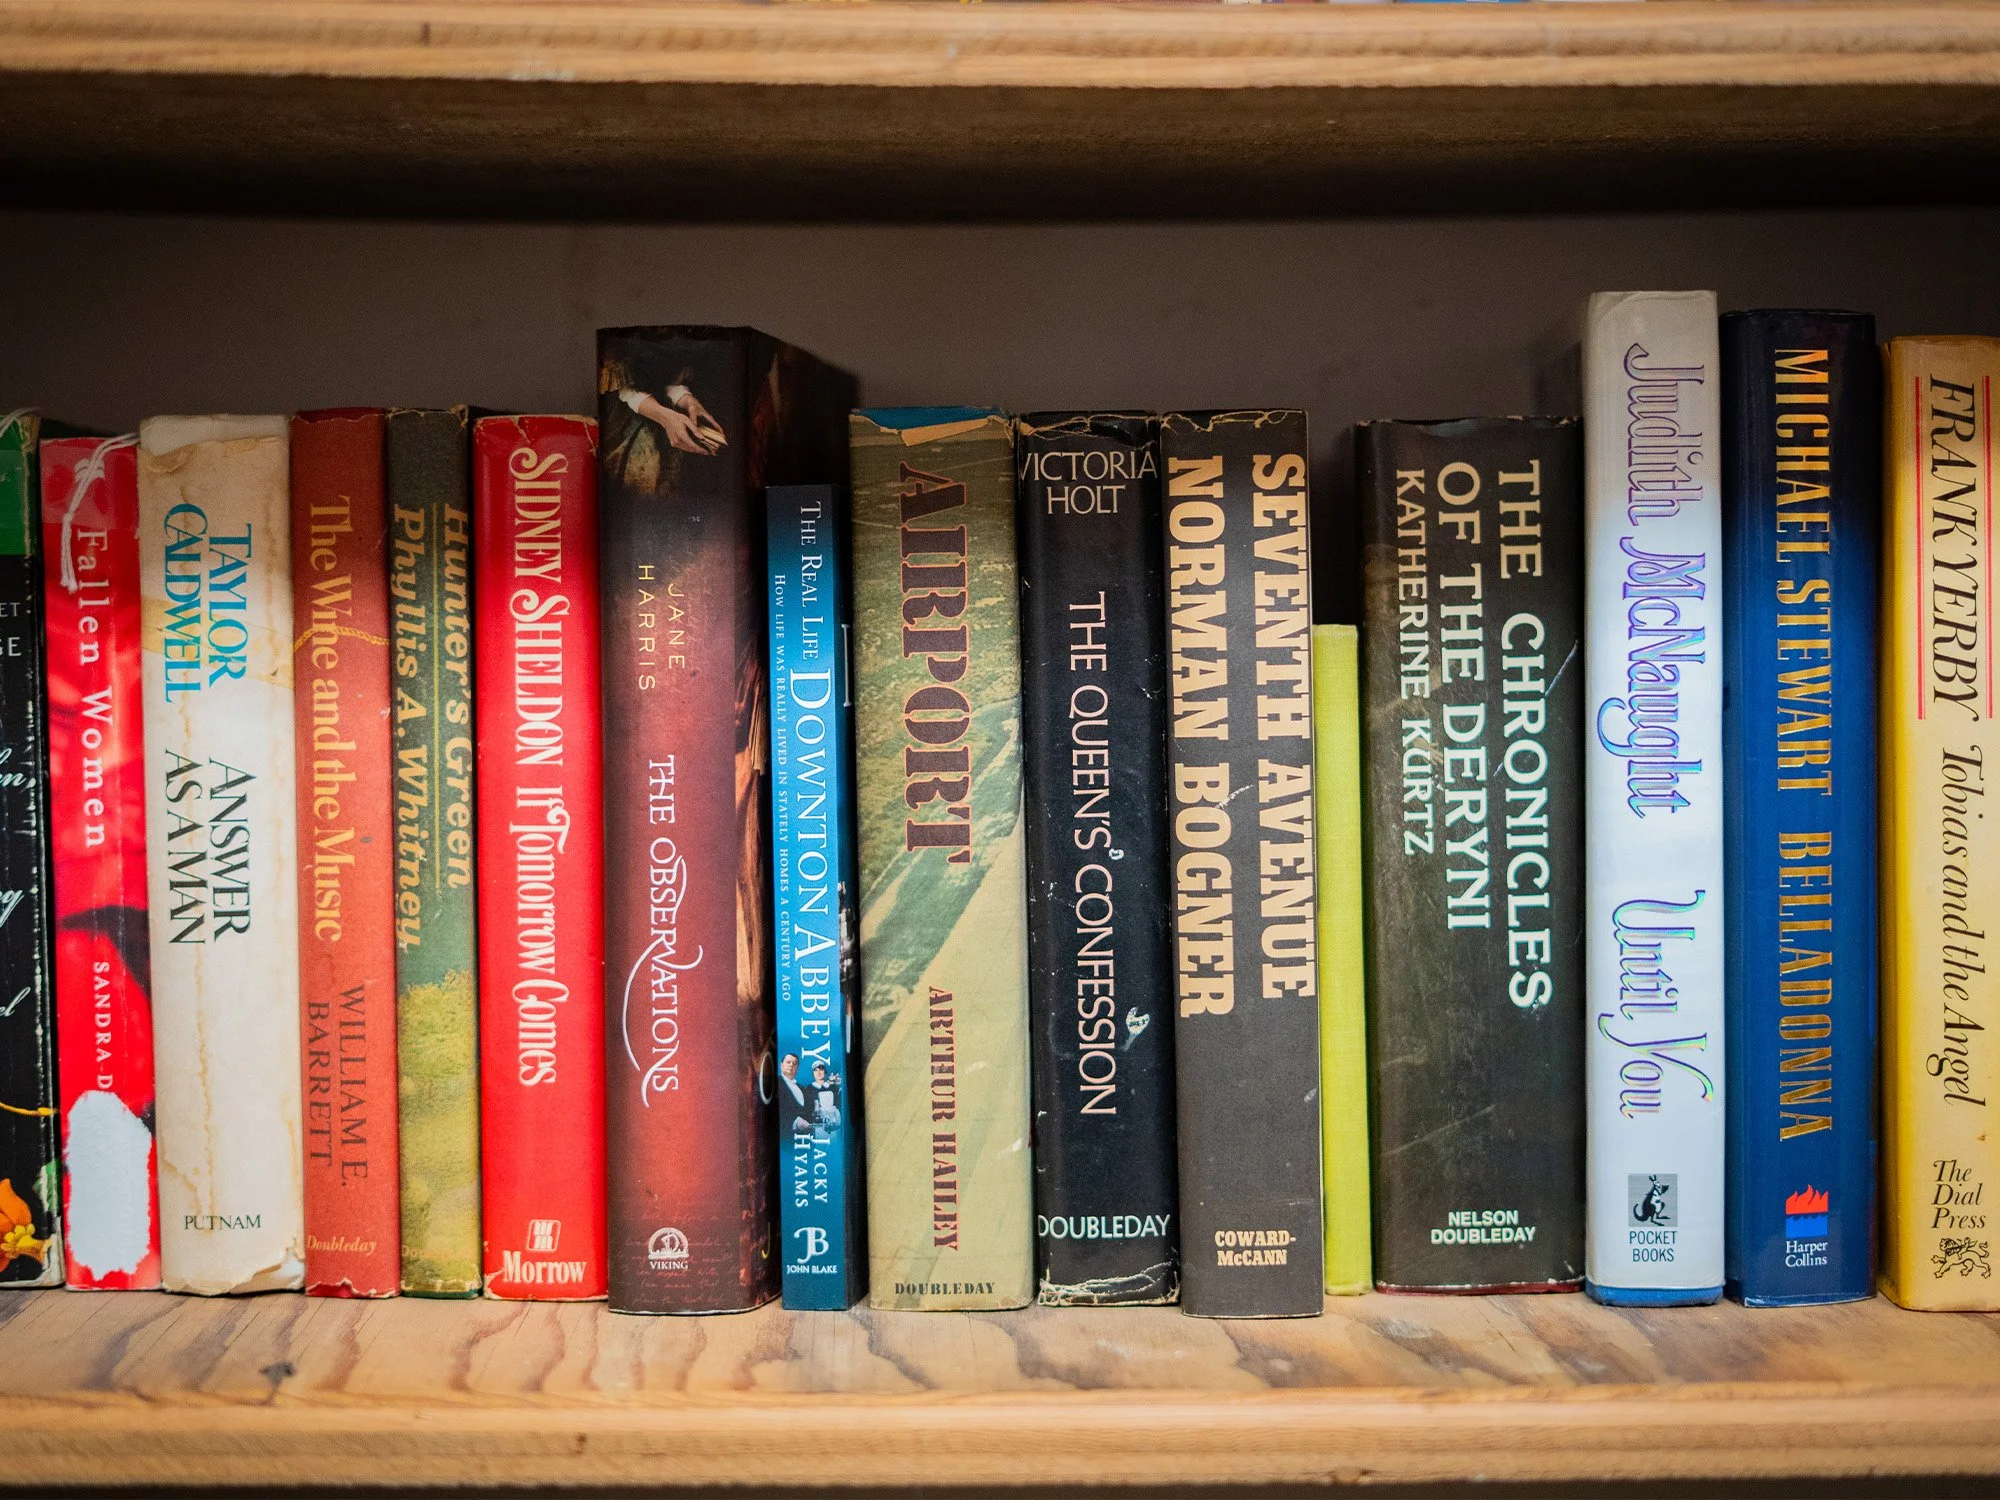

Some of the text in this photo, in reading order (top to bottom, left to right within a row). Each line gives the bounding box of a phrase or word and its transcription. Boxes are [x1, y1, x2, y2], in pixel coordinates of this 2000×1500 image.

[508, 447, 569, 584] SIDNEY
[1046, 485, 1126, 515] HOLT
[164, 503, 208, 703] CALDWELL
[208, 523, 252, 689] TAYLOR
[1597, 342, 1706, 819] Judith McNaught
[638, 565, 656, 691] HARRIS
[668, 583, 685, 670] JANE
[776, 614, 785, 639] LIFE
[776, 646, 785, 671] WAS
[900, 461, 973, 864] AIRPORT
[1396, 469, 1435, 855] KATHERINE KURTZ
[76, 529, 114, 848] Fallen Women
[309, 495, 358, 942] The Wine and the Music
[509, 589, 570, 767] SHELDON
[776, 677, 787, 722] REALLY
[1437, 462, 1492, 930] OF THE DERYNI
[393, 504, 428, 947] Phyllis A. Whitney
[777, 728, 787, 769] LIVED
[1168, 455, 1235, 1018] NORMAN BOGNER
[1252, 453, 1316, 999] SEVENTH AVENUE
[1498, 459, 1554, 1010] THE CHRONICLES
[1774, 348, 1833, 1143] MICHAEL STEWART BELLADONNA
[1926, 373, 1986, 1106] FRANK YERBY Tobias and the Angel
[446, 737, 474, 889] Green
[778, 771, 787, 785] IN
[779, 791, 788, 842] STATELY
[165, 749, 208, 945] AS A MAN
[208, 758, 257, 943] ANSWER
[509, 806, 570, 975] Tomorrow
[779, 849, 789, 892] HOMES
[1068, 591, 1117, 1116] THE QUEEN'S CONFESSION
[623, 754, 703, 1108] THE OBSERVATIONS
[781, 897, 788, 905] A
[781, 911, 790, 968] CENTURY
[93, 961, 112, 1063] SANDRA
[781, 974, 791, 1001] AGO
[1597, 889, 1714, 1120] Until You
[512, 979, 569, 1088] Comes
[307, 1001, 333, 1166] BARRETT
[339, 984, 369, 1187] WILLIAM E.
[929, 985, 959, 1252] ARTHUR HAILEY
[1931, 1183, 1983, 1206] Dial
[1933, 1159, 1972, 1182] The
[184, 1213, 261, 1231] PUTNAM
[307, 1234, 377, 1257] Doubleday
[1038, 1214, 1171, 1239] DOUBLEDAY
[1214, 1230, 1296, 1247] COWARD-
[1217, 1249, 1287, 1267] McCANN
[1430, 1226, 1536, 1245] DOUBLEDAY
[1448, 1210, 1519, 1227] NELSON
[1629, 1230, 1678, 1245] POCKET
[1632, 1247, 1675, 1262] BOOKS
[1785, 1240, 1828, 1254] Harper
[1785, 1255, 1828, 1267] Collins
[1930, 1207, 1986, 1230] Press
[502, 1249, 587, 1284] Morrow
[649, 1260, 689, 1270] VIKING
[786, 1264, 838, 1274] JOHN BLAKE
[895, 1281, 996, 1296] DOUBLEDAY
